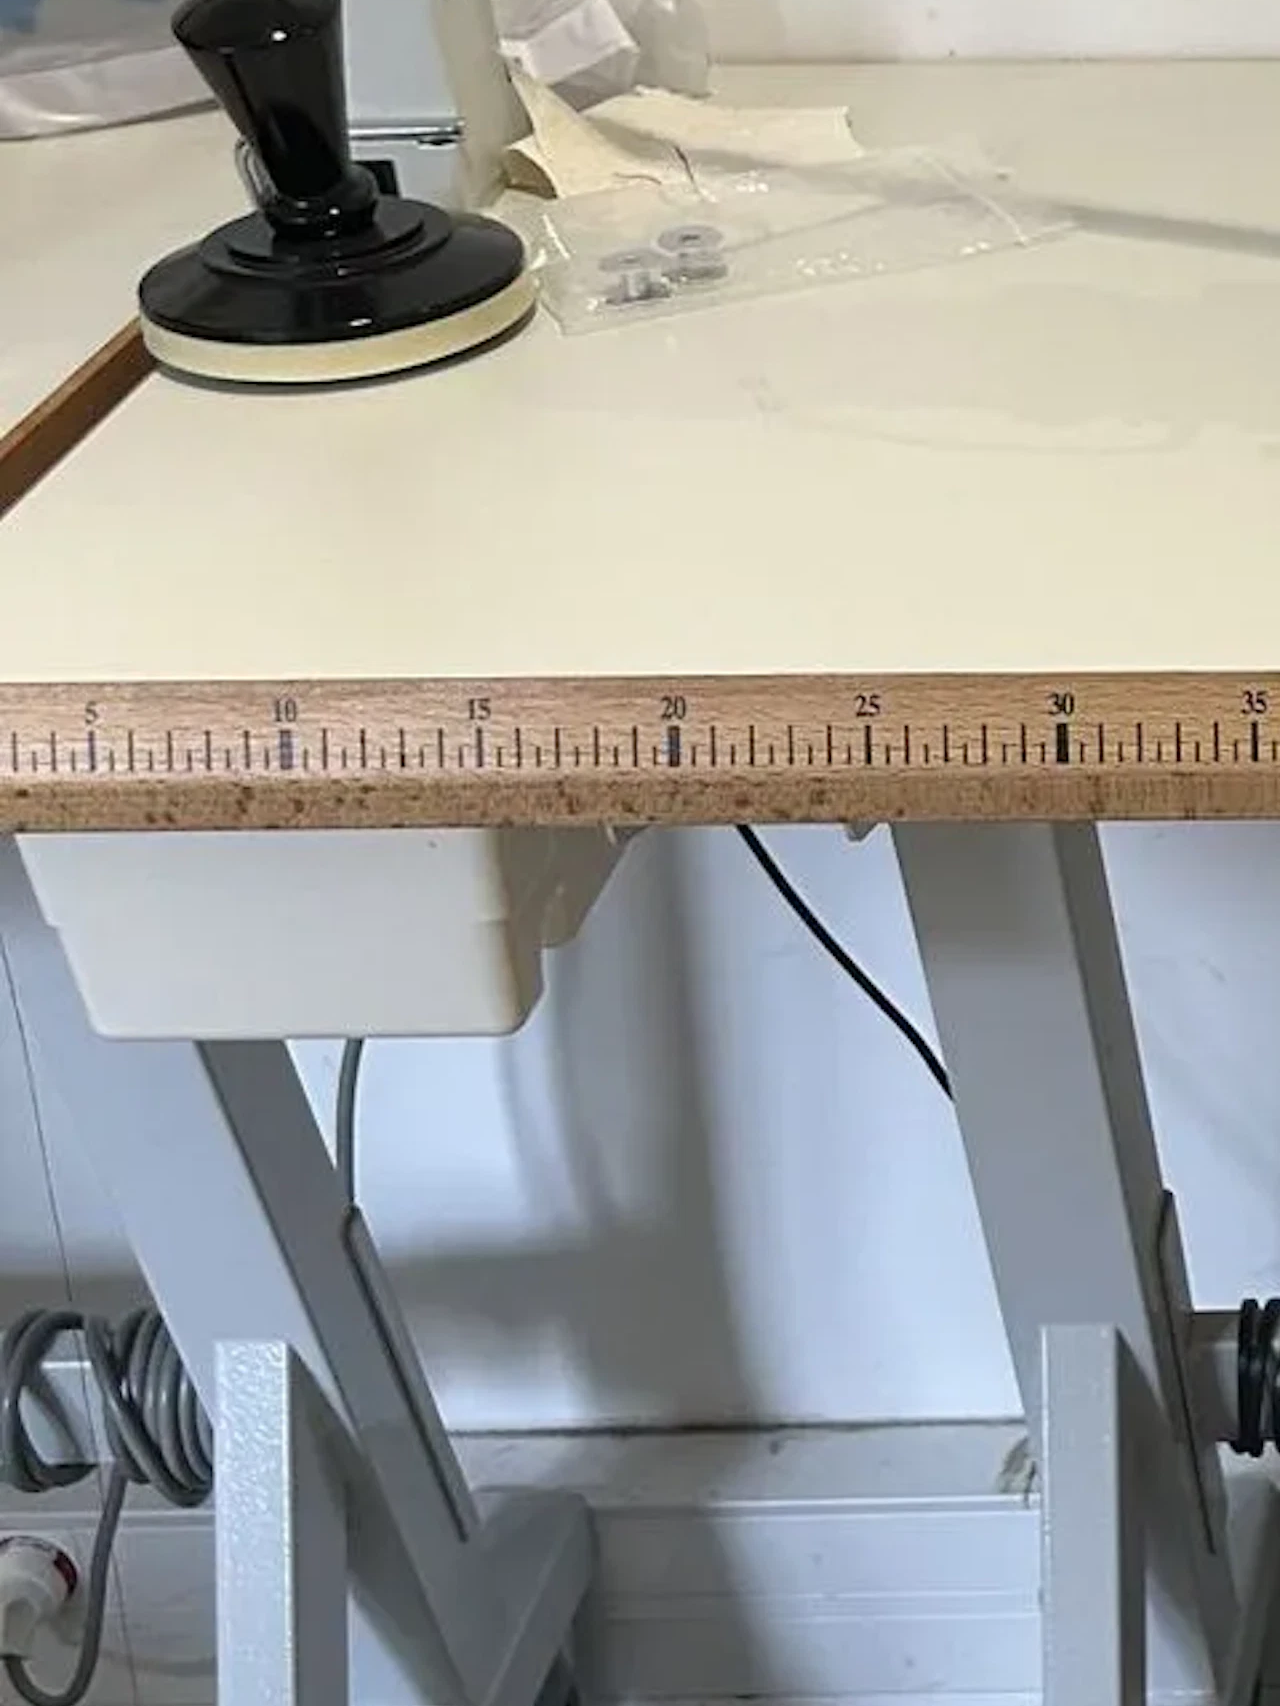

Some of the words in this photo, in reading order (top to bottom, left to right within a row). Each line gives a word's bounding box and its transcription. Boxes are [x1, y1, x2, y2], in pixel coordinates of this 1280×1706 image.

[85, 700, 98, 725] 5
[275, 697, 297, 722] 10
[468, 698, 491, 721] 15
[661, 696, 686, 720] 20
[854, 694, 880, 717] 25
[1048, 692, 1075, 716] 30
[1241, 690, 1267, 715] 35
